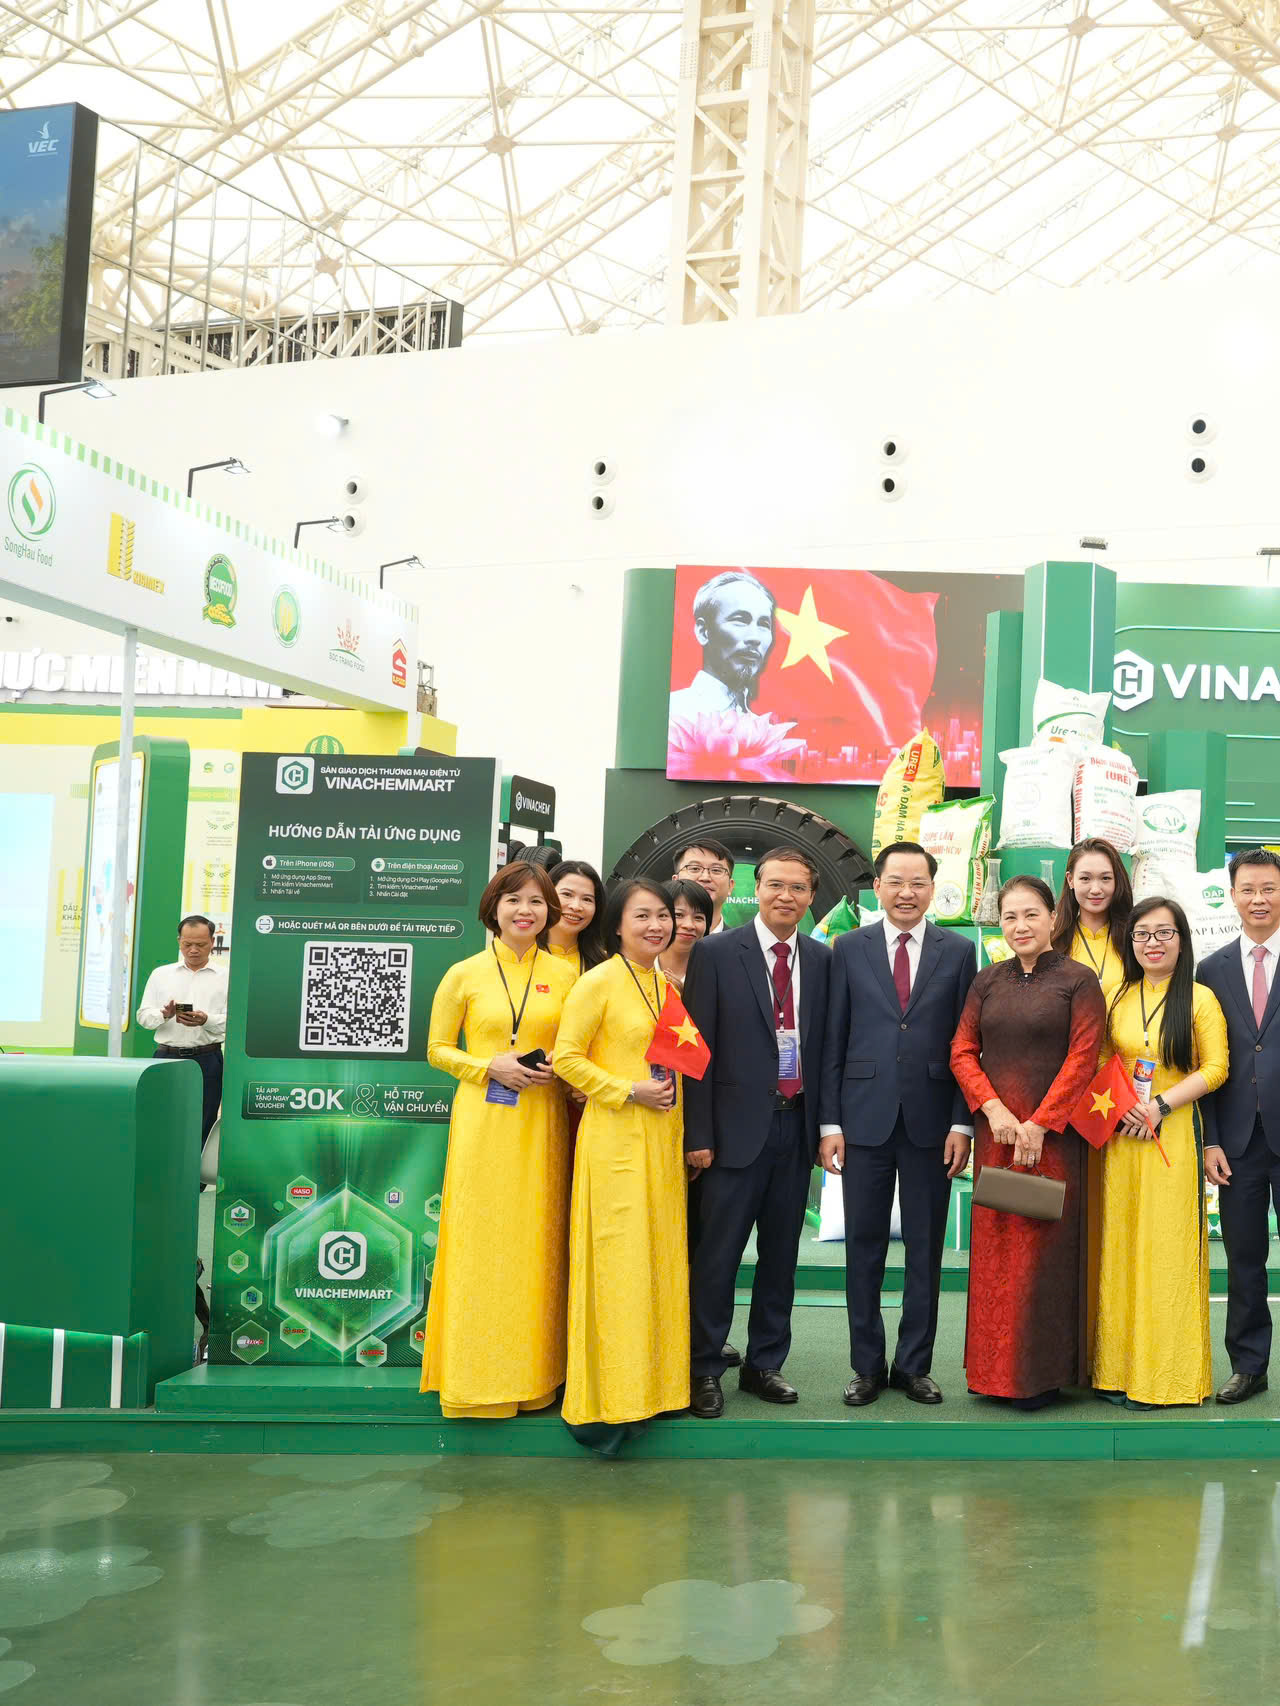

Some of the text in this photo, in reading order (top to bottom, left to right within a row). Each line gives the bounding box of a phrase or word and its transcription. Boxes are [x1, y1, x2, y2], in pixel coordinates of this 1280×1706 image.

[907, 750, 920, 775] UREA
[320, 766, 337, 774] SÀN
[338, 767, 357, 775] GIAO
[358, 767, 378, 776] DỊCH
[379, 767, 412, 776] THƯƠNG
[413, 769, 428, 777] MẠI
[429, 769, 448, 778] ĐIỆN
[325, 777, 455, 792] VINACHEMMART
[522, 796, 551, 815] VINACHEM
[268, 822, 461, 844] HƯỚNG DẪN TẢI ỨNG DỤNG
[295, 860, 317, 868] iPhone
[726, 896, 759, 904] INACHE
[278, 920, 456, 933] HOẶC QUÉT MÃ QR BÊN DƯỚI ĐỂ TẢI TRỰC TIẾP
[289, 1088, 345, 1110] 30K
[384, 1086, 425, 1101] HỖ TRỢ
[383, 1099, 449, 1113] VẬN CHUYỂN
[295, 1287, 393, 1300] VINACHEMMART
